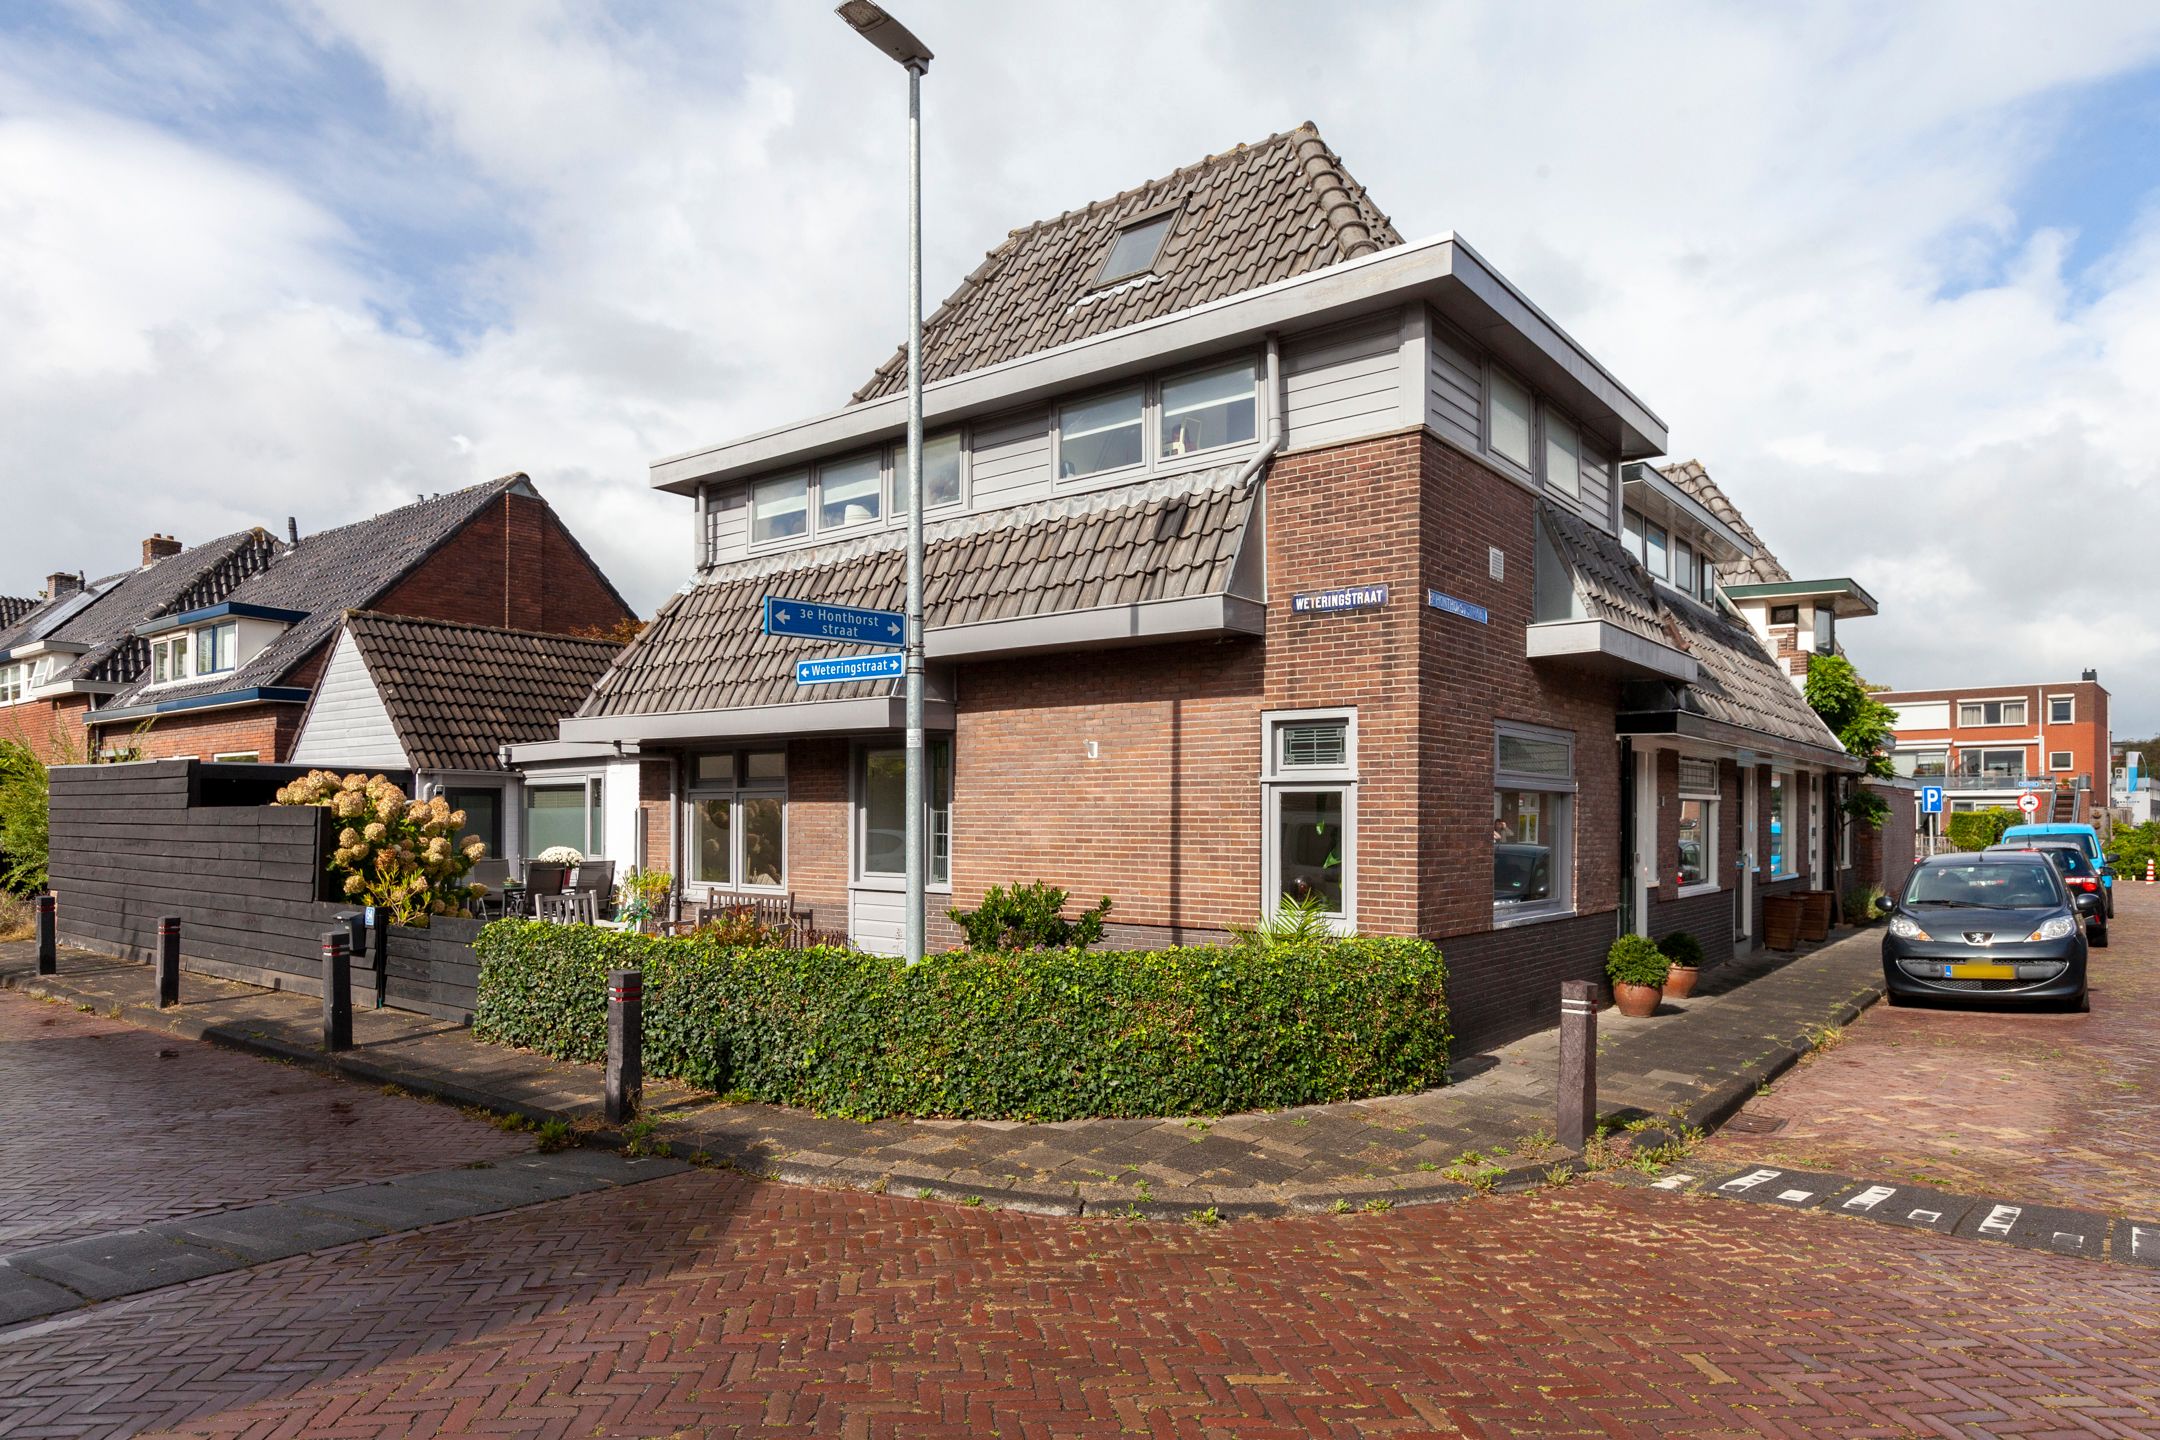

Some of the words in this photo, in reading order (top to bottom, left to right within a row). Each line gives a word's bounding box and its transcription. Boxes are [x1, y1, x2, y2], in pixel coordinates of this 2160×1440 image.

[1295, 589, 1383, 611] WETERINGSTRAAT
[800, 608, 814, 619] 3e
[818, 608, 879, 627] Honthorst
[822, 624, 858, 638] straat
[811, 660, 888, 677] Weteringstraat
[1926, 789, 1938, 811] P
